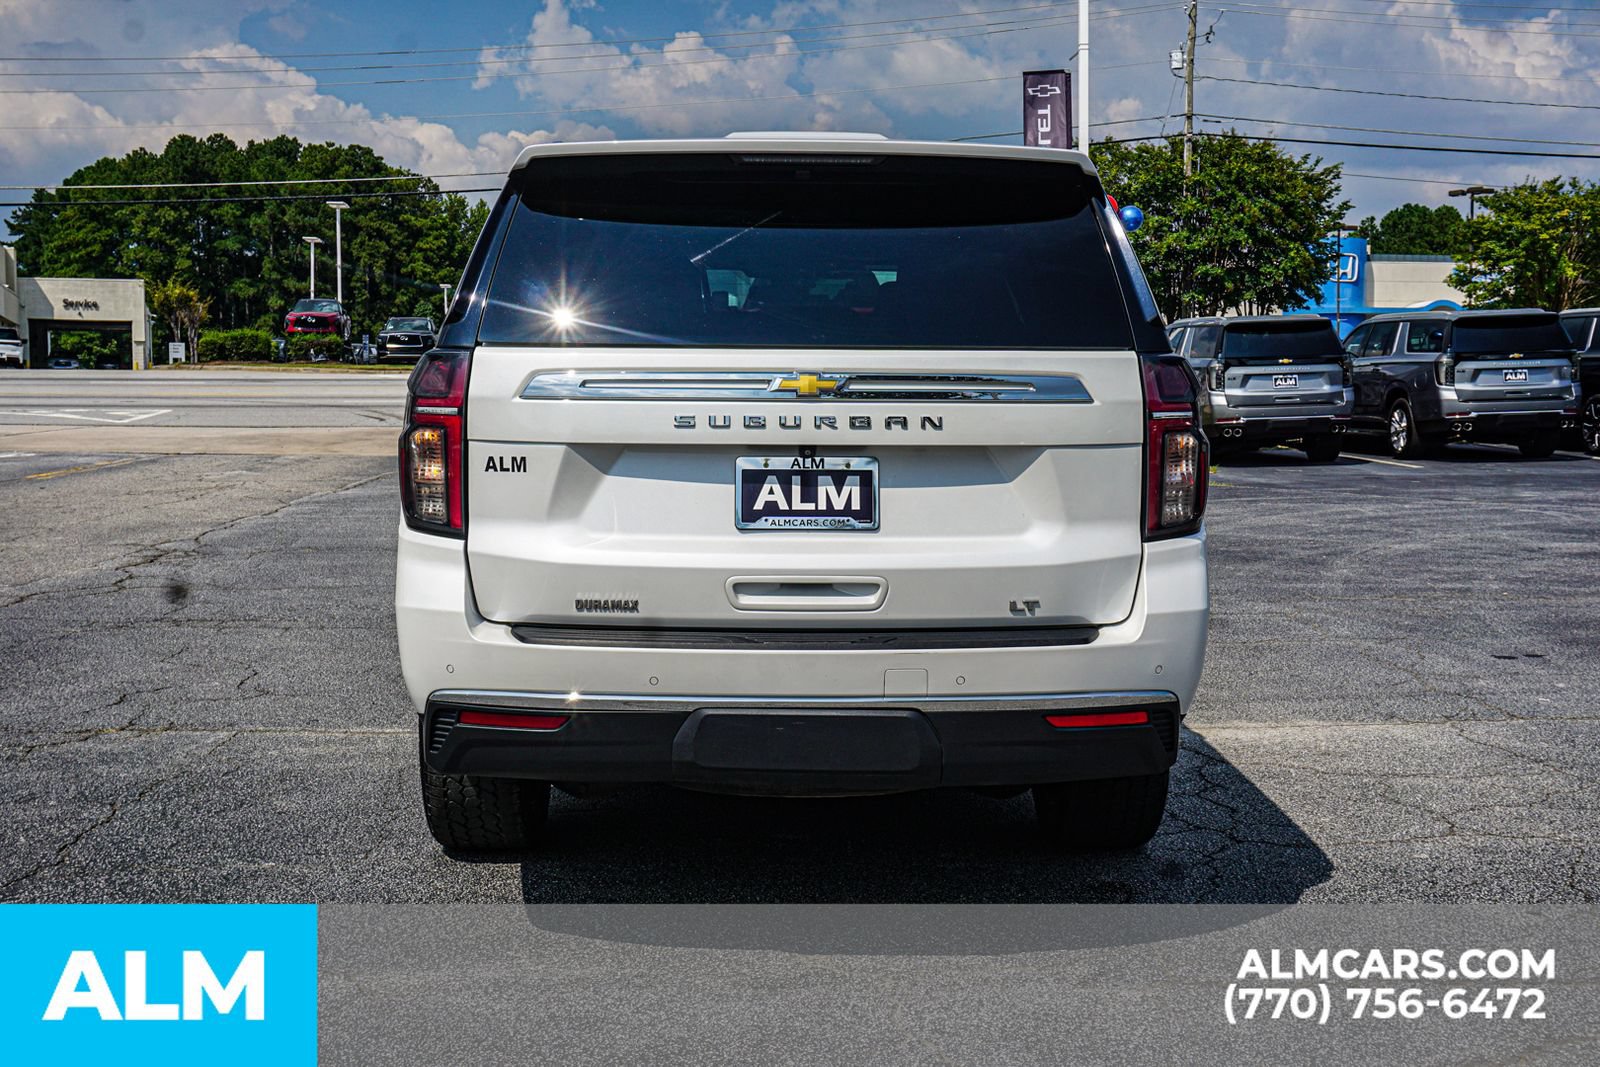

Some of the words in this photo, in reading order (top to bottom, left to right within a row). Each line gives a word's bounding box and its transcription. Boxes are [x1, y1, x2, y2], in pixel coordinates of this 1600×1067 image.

[62, 298, 99, 310] Service
[673, 415, 944, 430] SUBURBAN
[484, 455, 527, 472] ALM
[790, 457, 825, 469] ALM
[752, 475, 861, 510] ALM
[769, 518, 845, 528] ALMCARS.COM
[574, 599, 640, 612] DURAMAX
[1008, 600, 1041, 615] LT
